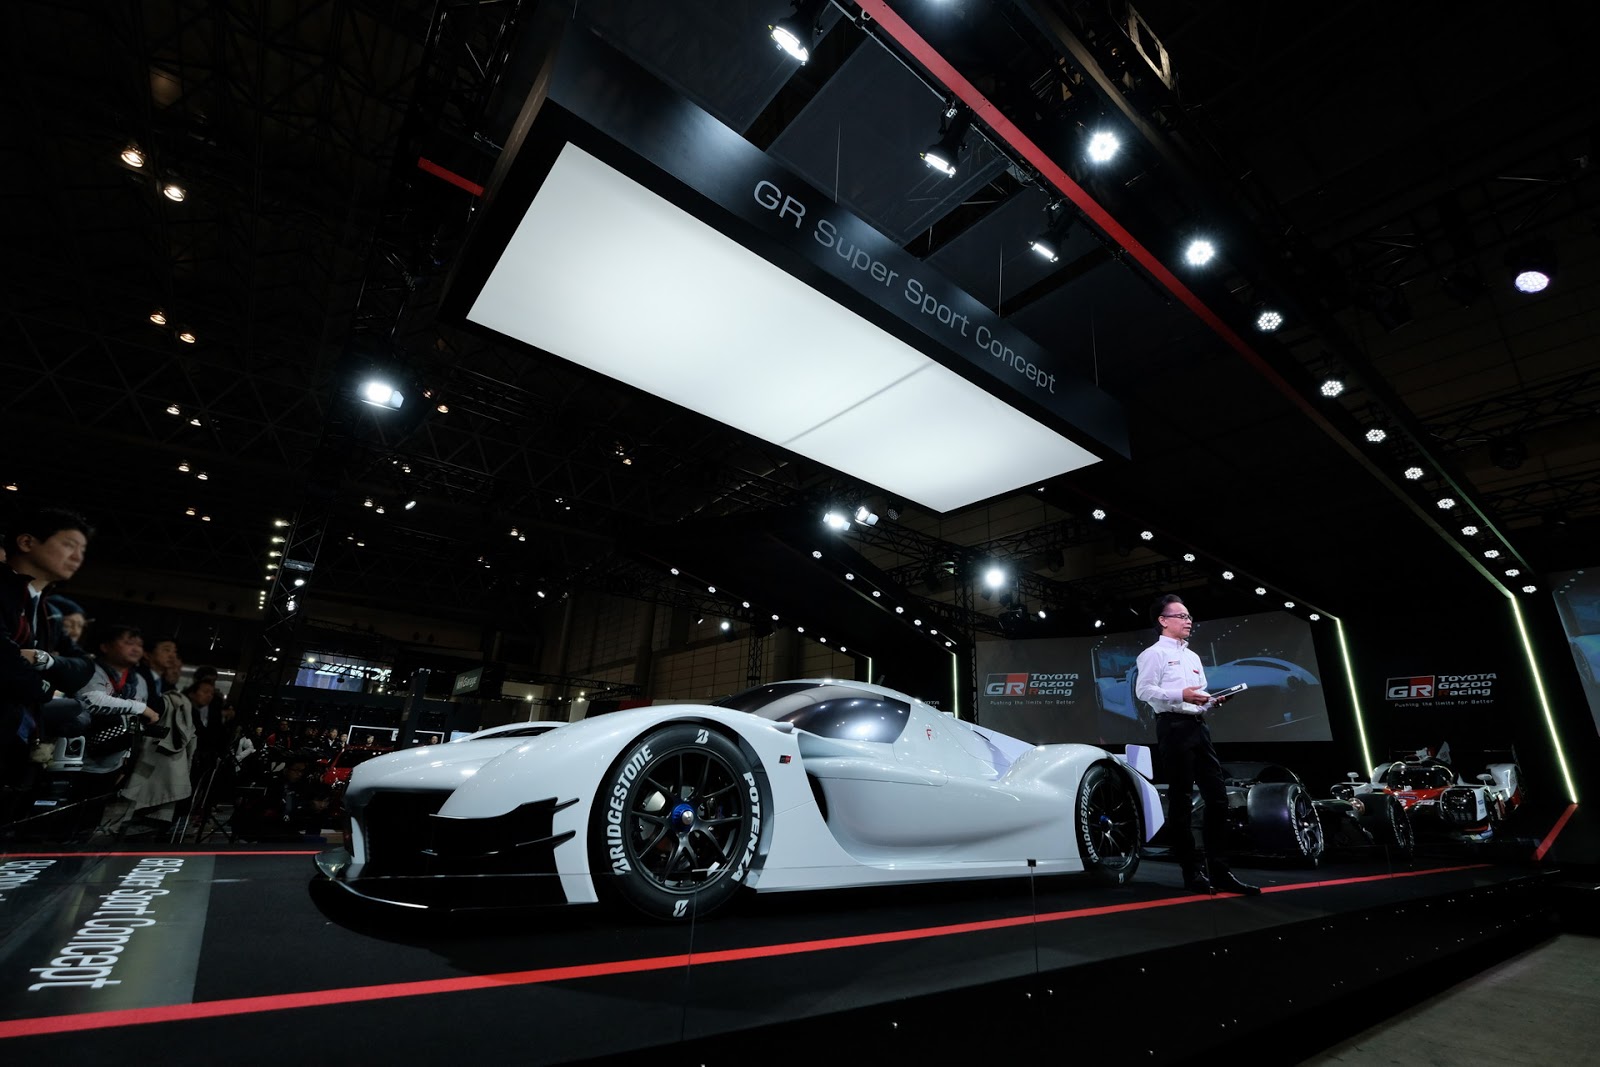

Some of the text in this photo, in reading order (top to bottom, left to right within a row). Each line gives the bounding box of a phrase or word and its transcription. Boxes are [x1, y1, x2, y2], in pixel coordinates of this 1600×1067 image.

[753, 180, 1056, 394] GR Super Sport Concept
[1029, 680, 1074, 688] GAZOO
[1438, 673, 1497, 682] TOYOTA
[985, 682, 1026, 695] GR
[1028, 687, 1072, 697] Racing
[1388, 685, 1432, 698] GR
[1438, 681, 1492, 690] GAZOO
[1438, 688, 1491, 697] Racing
[606, 744, 653, 876] BRIDGESTONE
[731, 771, 761, 882] POTENZA
[118, 867, 180, 888] Super
[93, 888, 170, 916] Sport
[28, 918, 156, 991] Concept
